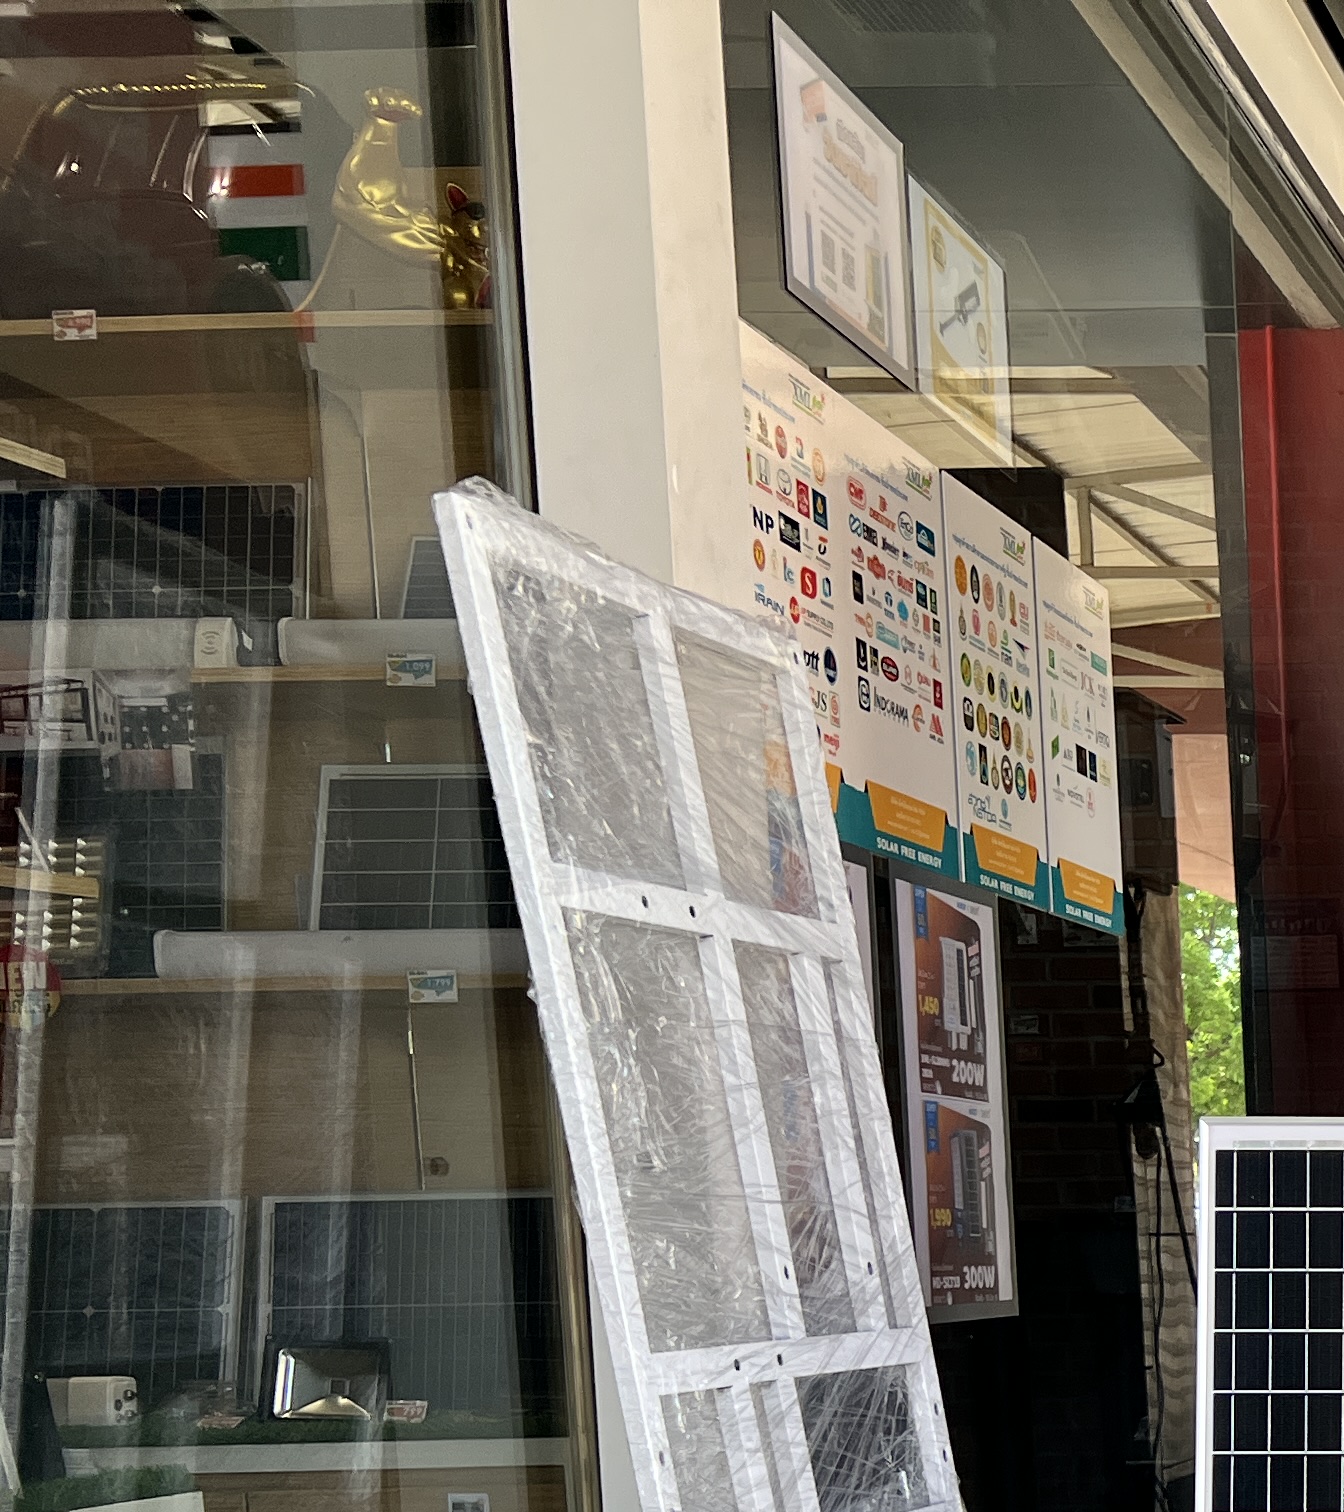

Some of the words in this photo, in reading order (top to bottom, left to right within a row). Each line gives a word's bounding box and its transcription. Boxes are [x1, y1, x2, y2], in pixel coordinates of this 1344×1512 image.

[752, 506, 775, 534] NP
[876, 836, 899, 855] SOLAR
[900, 845, 916, 860] FREE
[918, 851, 942, 869] ENERGY
[980, 874, 999, 889] SOLAR
[1000, 881, 1013, 894] FREE
[1013, 885, 1034, 901] ENERGY
[952, 1058, 985, 1087] 200W
[963, 1265, 996, 1290] 300W
